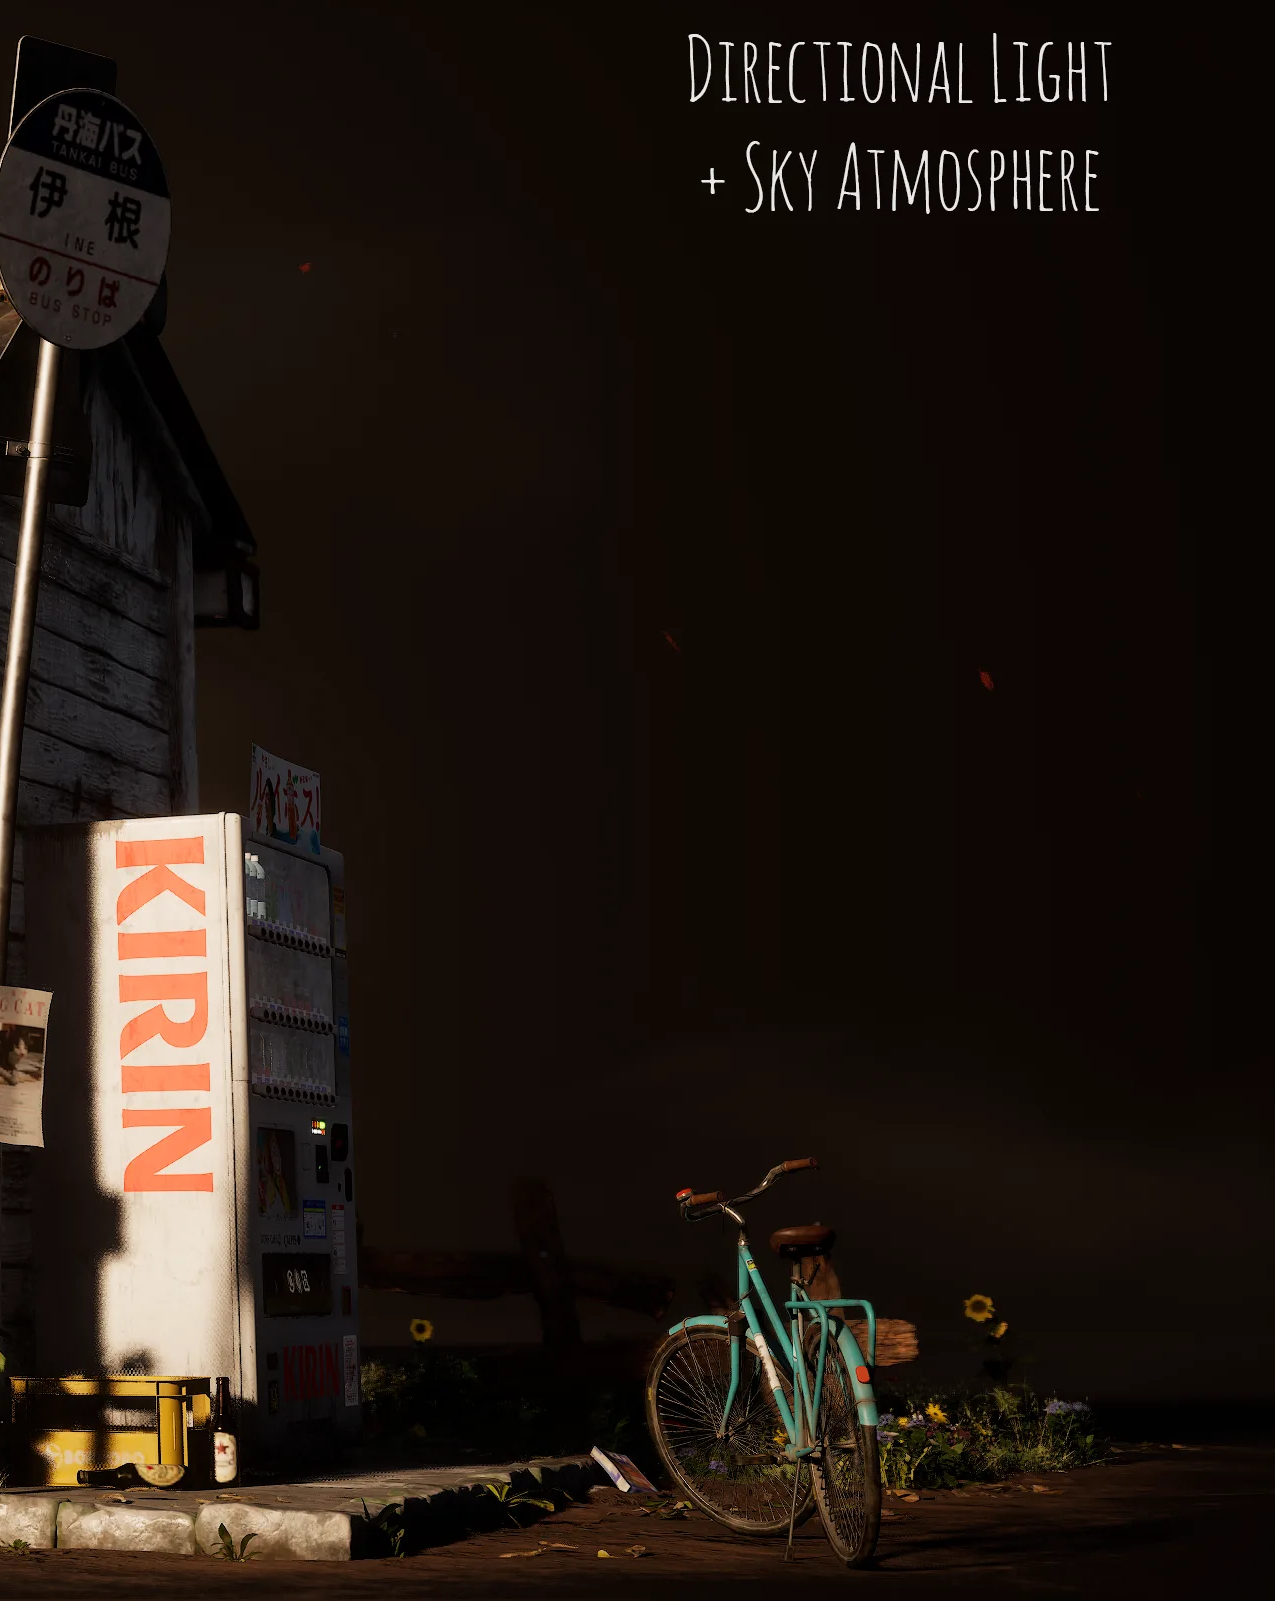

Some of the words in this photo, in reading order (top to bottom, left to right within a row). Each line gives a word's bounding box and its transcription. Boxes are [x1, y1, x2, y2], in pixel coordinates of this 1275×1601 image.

[52, 103, 143, 166] 丹海バス
[51, 140, 102, 169] TANKAI
[110, 162, 139, 182] BUS
[29, 166, 142, 249] 伊根
[65, 232, 95, 256] INE
[29, 256, 121, 308] のりば
[29, 292, 61, 313] BUS
[72, 304, 112, 327] STOP
[14, 998, 46, 1017] CAT
[115, 835, 214, 1193] KIRIN
[284, 1343, 339, 1402] KIRIN
